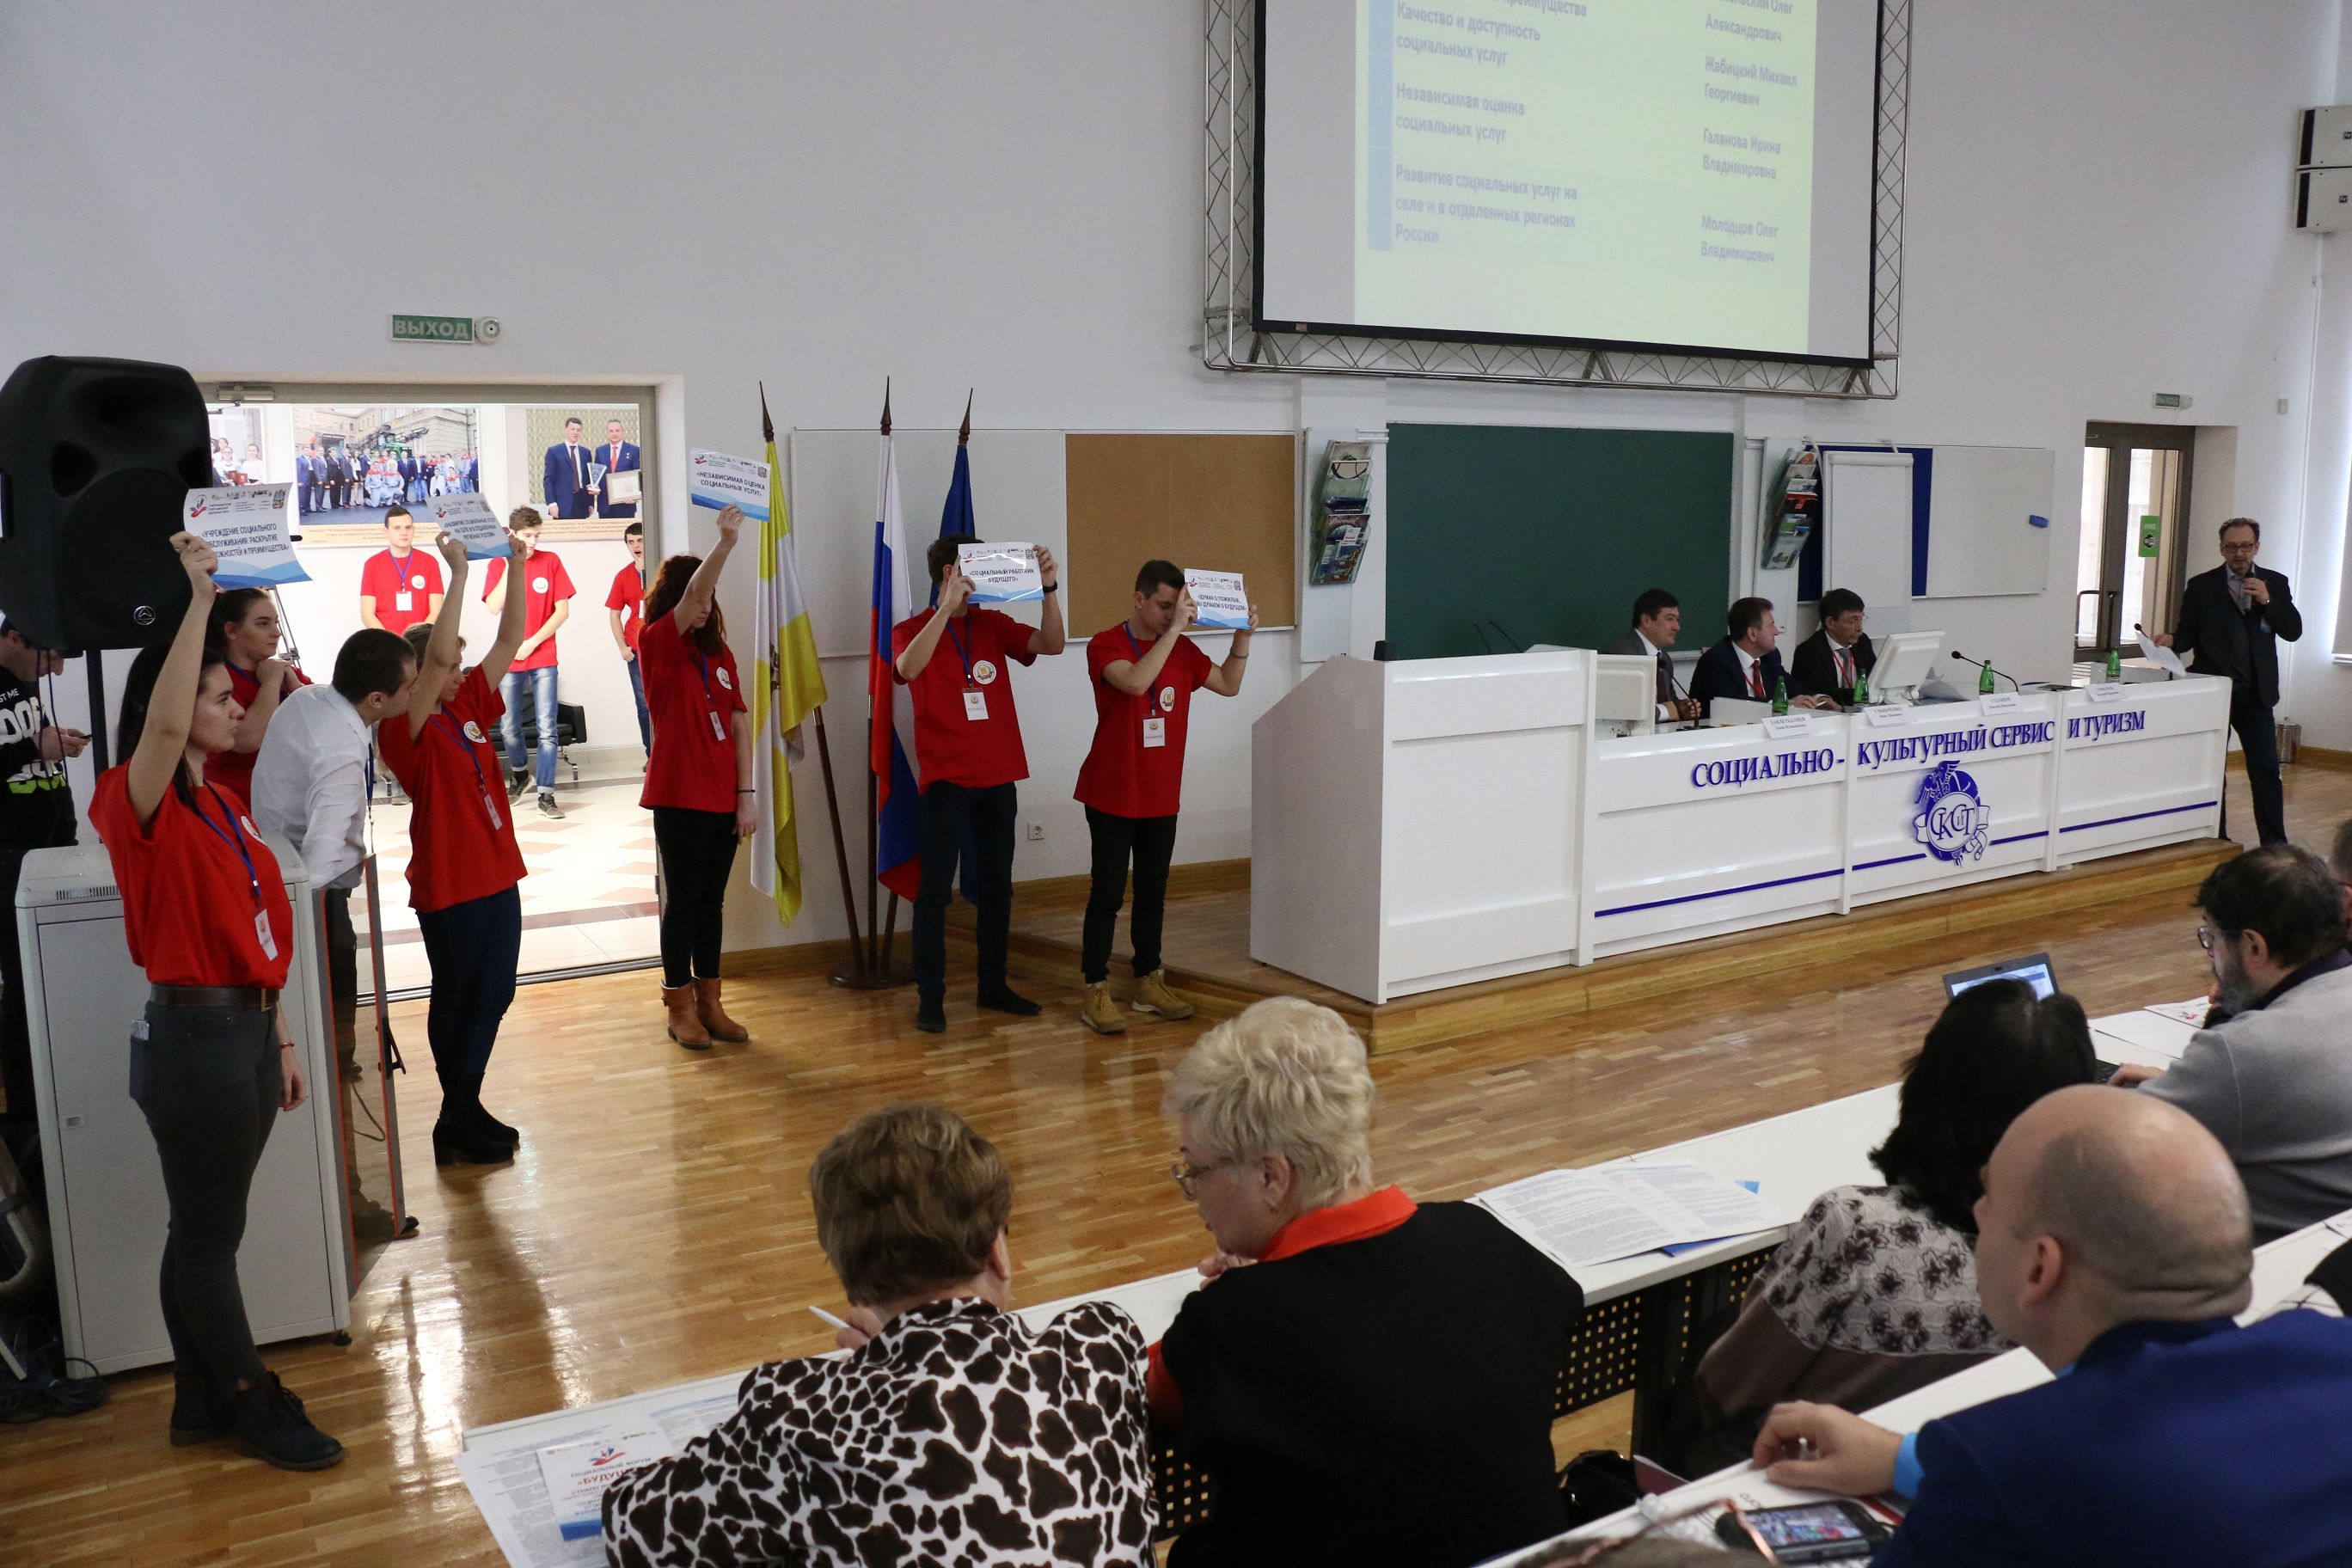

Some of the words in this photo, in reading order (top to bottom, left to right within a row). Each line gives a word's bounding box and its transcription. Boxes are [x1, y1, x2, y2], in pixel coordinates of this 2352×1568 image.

[1398, 2, 1453, 26] Качество
[1456, 16, 1464, 28] и
[1467, 18, 1540, 40] доступность
[1706, 14, 1782, 42] Александрович
[1397, 34, 1473, 58] социальных
[1476, 46, 1508, 67] услуг
[1705, 56, 1757, 80] Жабицкий
[1759, 66, 1798, 86] Михаил
[1397, 83, 1479, 108] Независимая
[1482, 98, 1525, 115] оценка
[1704, 83, 1760, 106] Георгиевич
[1396, 115, 1472, 138] социальных
[1476, 126, 1506, 144] услуг
[1703, 128, 1748, 150] Галанова
[1750, 136, 1781, 154] Ирина
[1703, 155, 1776, 179] Владимировна
[1396, 164, 1453, 186] Развитие
[1455, 174, 1528, 194] социальных
[1531, 183, 1561, 202] услуг
[1564, 187, 1577, 200] на
[1395, 198, 1424, 212] селе
[1427, 201, 1436, 213] и
[1438, 202, 1445, 215] в
[1449, 201, 1520, 222] отдаленных
[1523, 211, 1576, 228] регионах
[1396, 224, 1440, 242] России
[1755, 221, 1779, 237] Олег
[1701, 241, 1775, 264] Владимирович
[395, 321, 469, 339] ВЫХОД
[696, 471, 743, 484] «НЕЗАВИСИМАЯ
[744, 480, 765, 490] ОЦЕНКА
[701, 480, 743, 492] СОЦИАЛЬНЫХ
[202, 527, 239, 537] «УЧРЕЖДЕНИЕ
[240, 524, 277, 535] СОЦИАЛЬНОГО
[249, 534, 279, 544] РАСКРЫТИЕ
[213, 547, 242, 558] ОЖНОСТЕЙ
[970, 567, 1008, 576] «СОЦИАЛЬНЫЙ
[7, 688, 20, 698] ME
[1857, 723, 1986, 769] КУЛЬТУРНЫЙ
[1989, 720, 2055, 748] СЕРВИС
[2067, 717, 2081, 738] И
[2082, 710, 2146, 741] ТУРИЗМ
